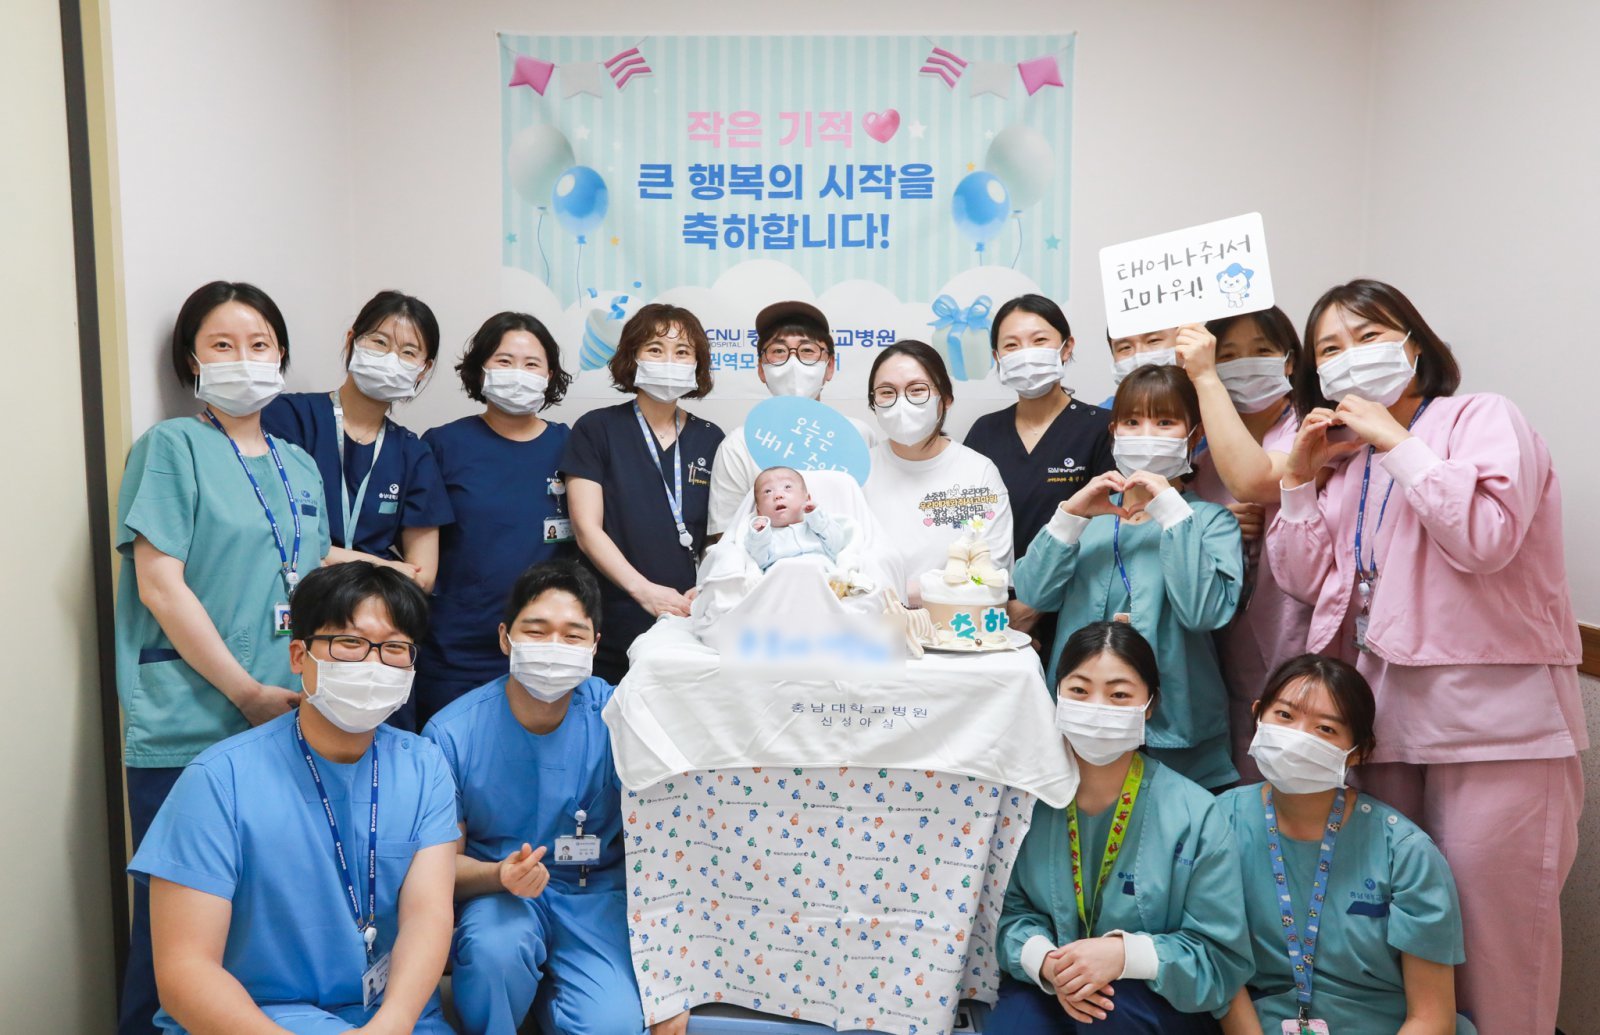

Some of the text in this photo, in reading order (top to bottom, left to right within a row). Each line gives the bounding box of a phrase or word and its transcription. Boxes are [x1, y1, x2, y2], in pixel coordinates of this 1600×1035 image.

[687, 110, 853, 148] 작은 기적
[638, 163, 935, 200] 큰 행복의 시작을
[682, 212, 890, 250] 축하합니다!
[1120, 276, 1203, 312] 고마워!
[705, 329, 740, 341] CNU
[755, 428, 795, 458] 내가
[791, 417, 835, 452] 오늘은
[792, 703, 927, 718] 충남대학교병원
